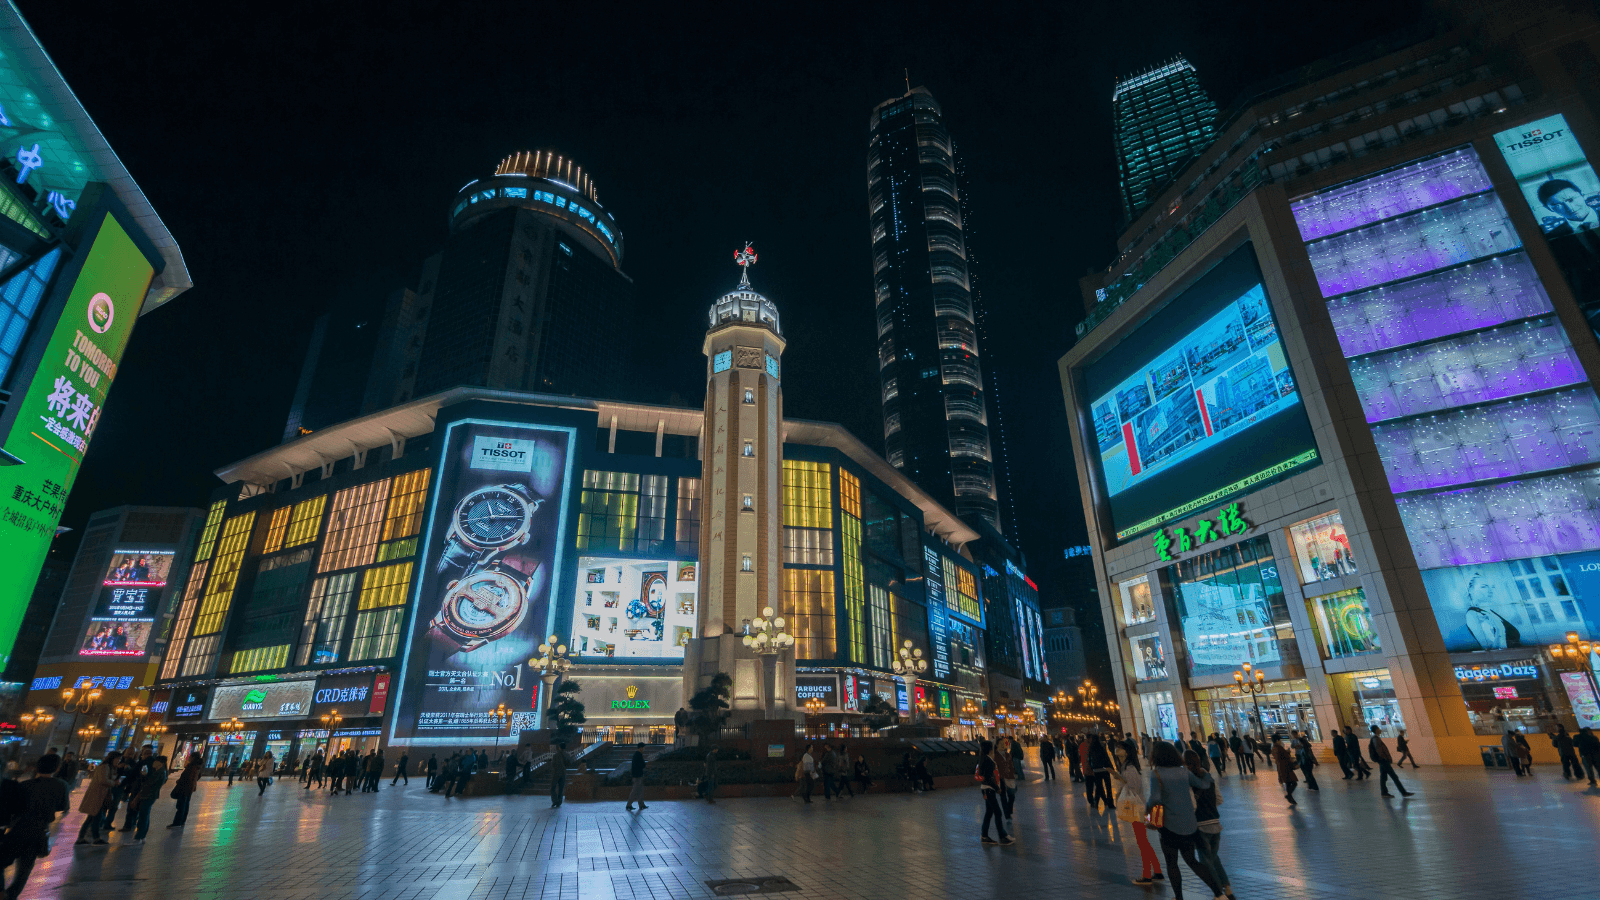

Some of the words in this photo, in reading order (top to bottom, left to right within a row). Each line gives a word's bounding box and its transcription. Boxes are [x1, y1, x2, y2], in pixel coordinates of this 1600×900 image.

[1506, 129, 1564, 151] TISSOT
[65, 348, 81, 373] TO
[79, 360, 101, 389] YOU
[481, 448, 526, 459] TISSOT
[1454, 664, 1538, 681] äagen-Dazs
[611, 700, 650, 709] ROLEX
